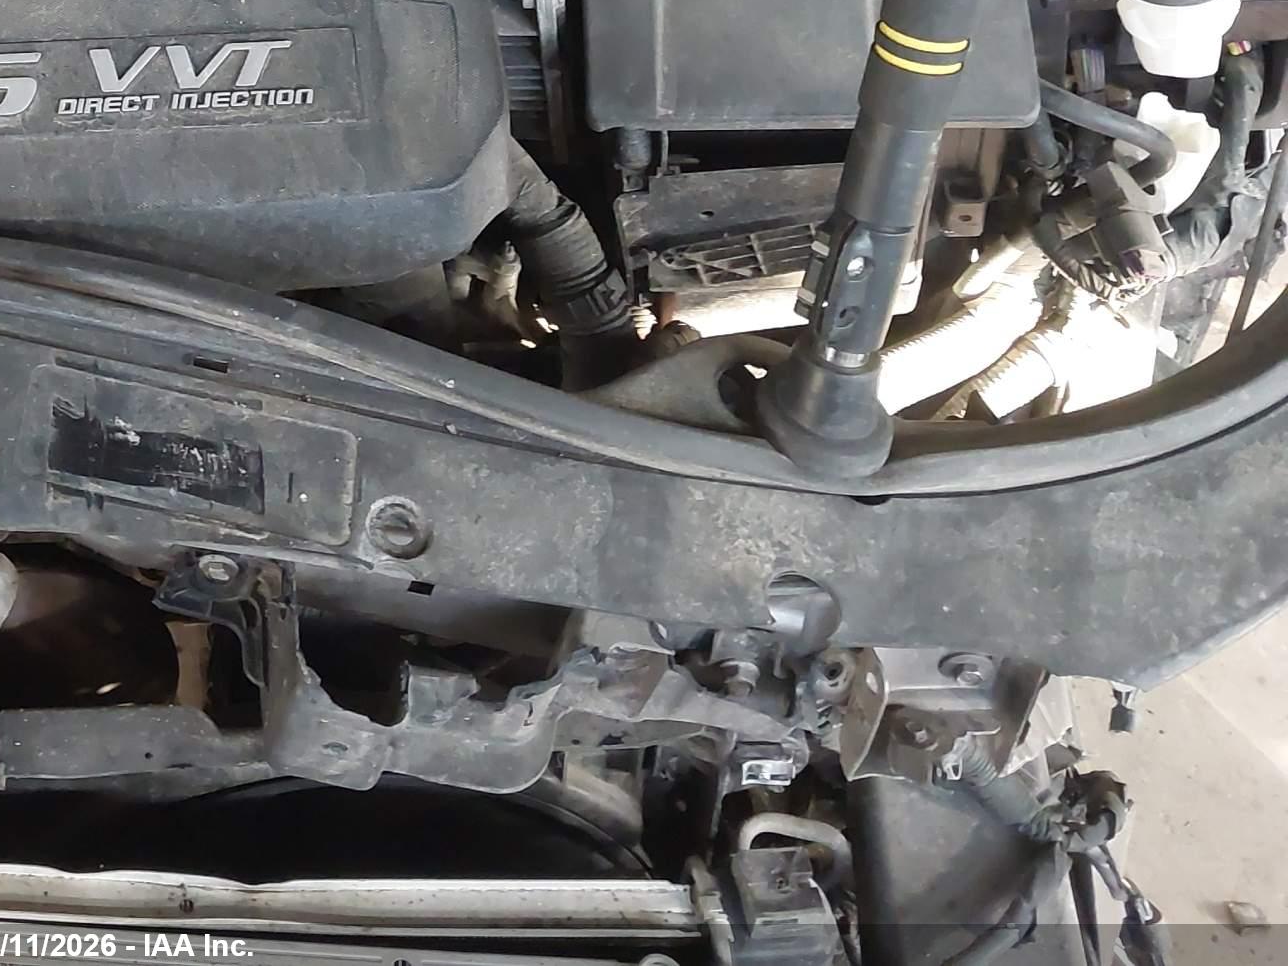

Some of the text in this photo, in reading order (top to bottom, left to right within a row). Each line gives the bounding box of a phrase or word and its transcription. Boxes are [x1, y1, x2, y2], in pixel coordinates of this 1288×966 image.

[89, 40, 292, 92] VVT
[57, 88, 313, 115] DIRECT INJECTION
